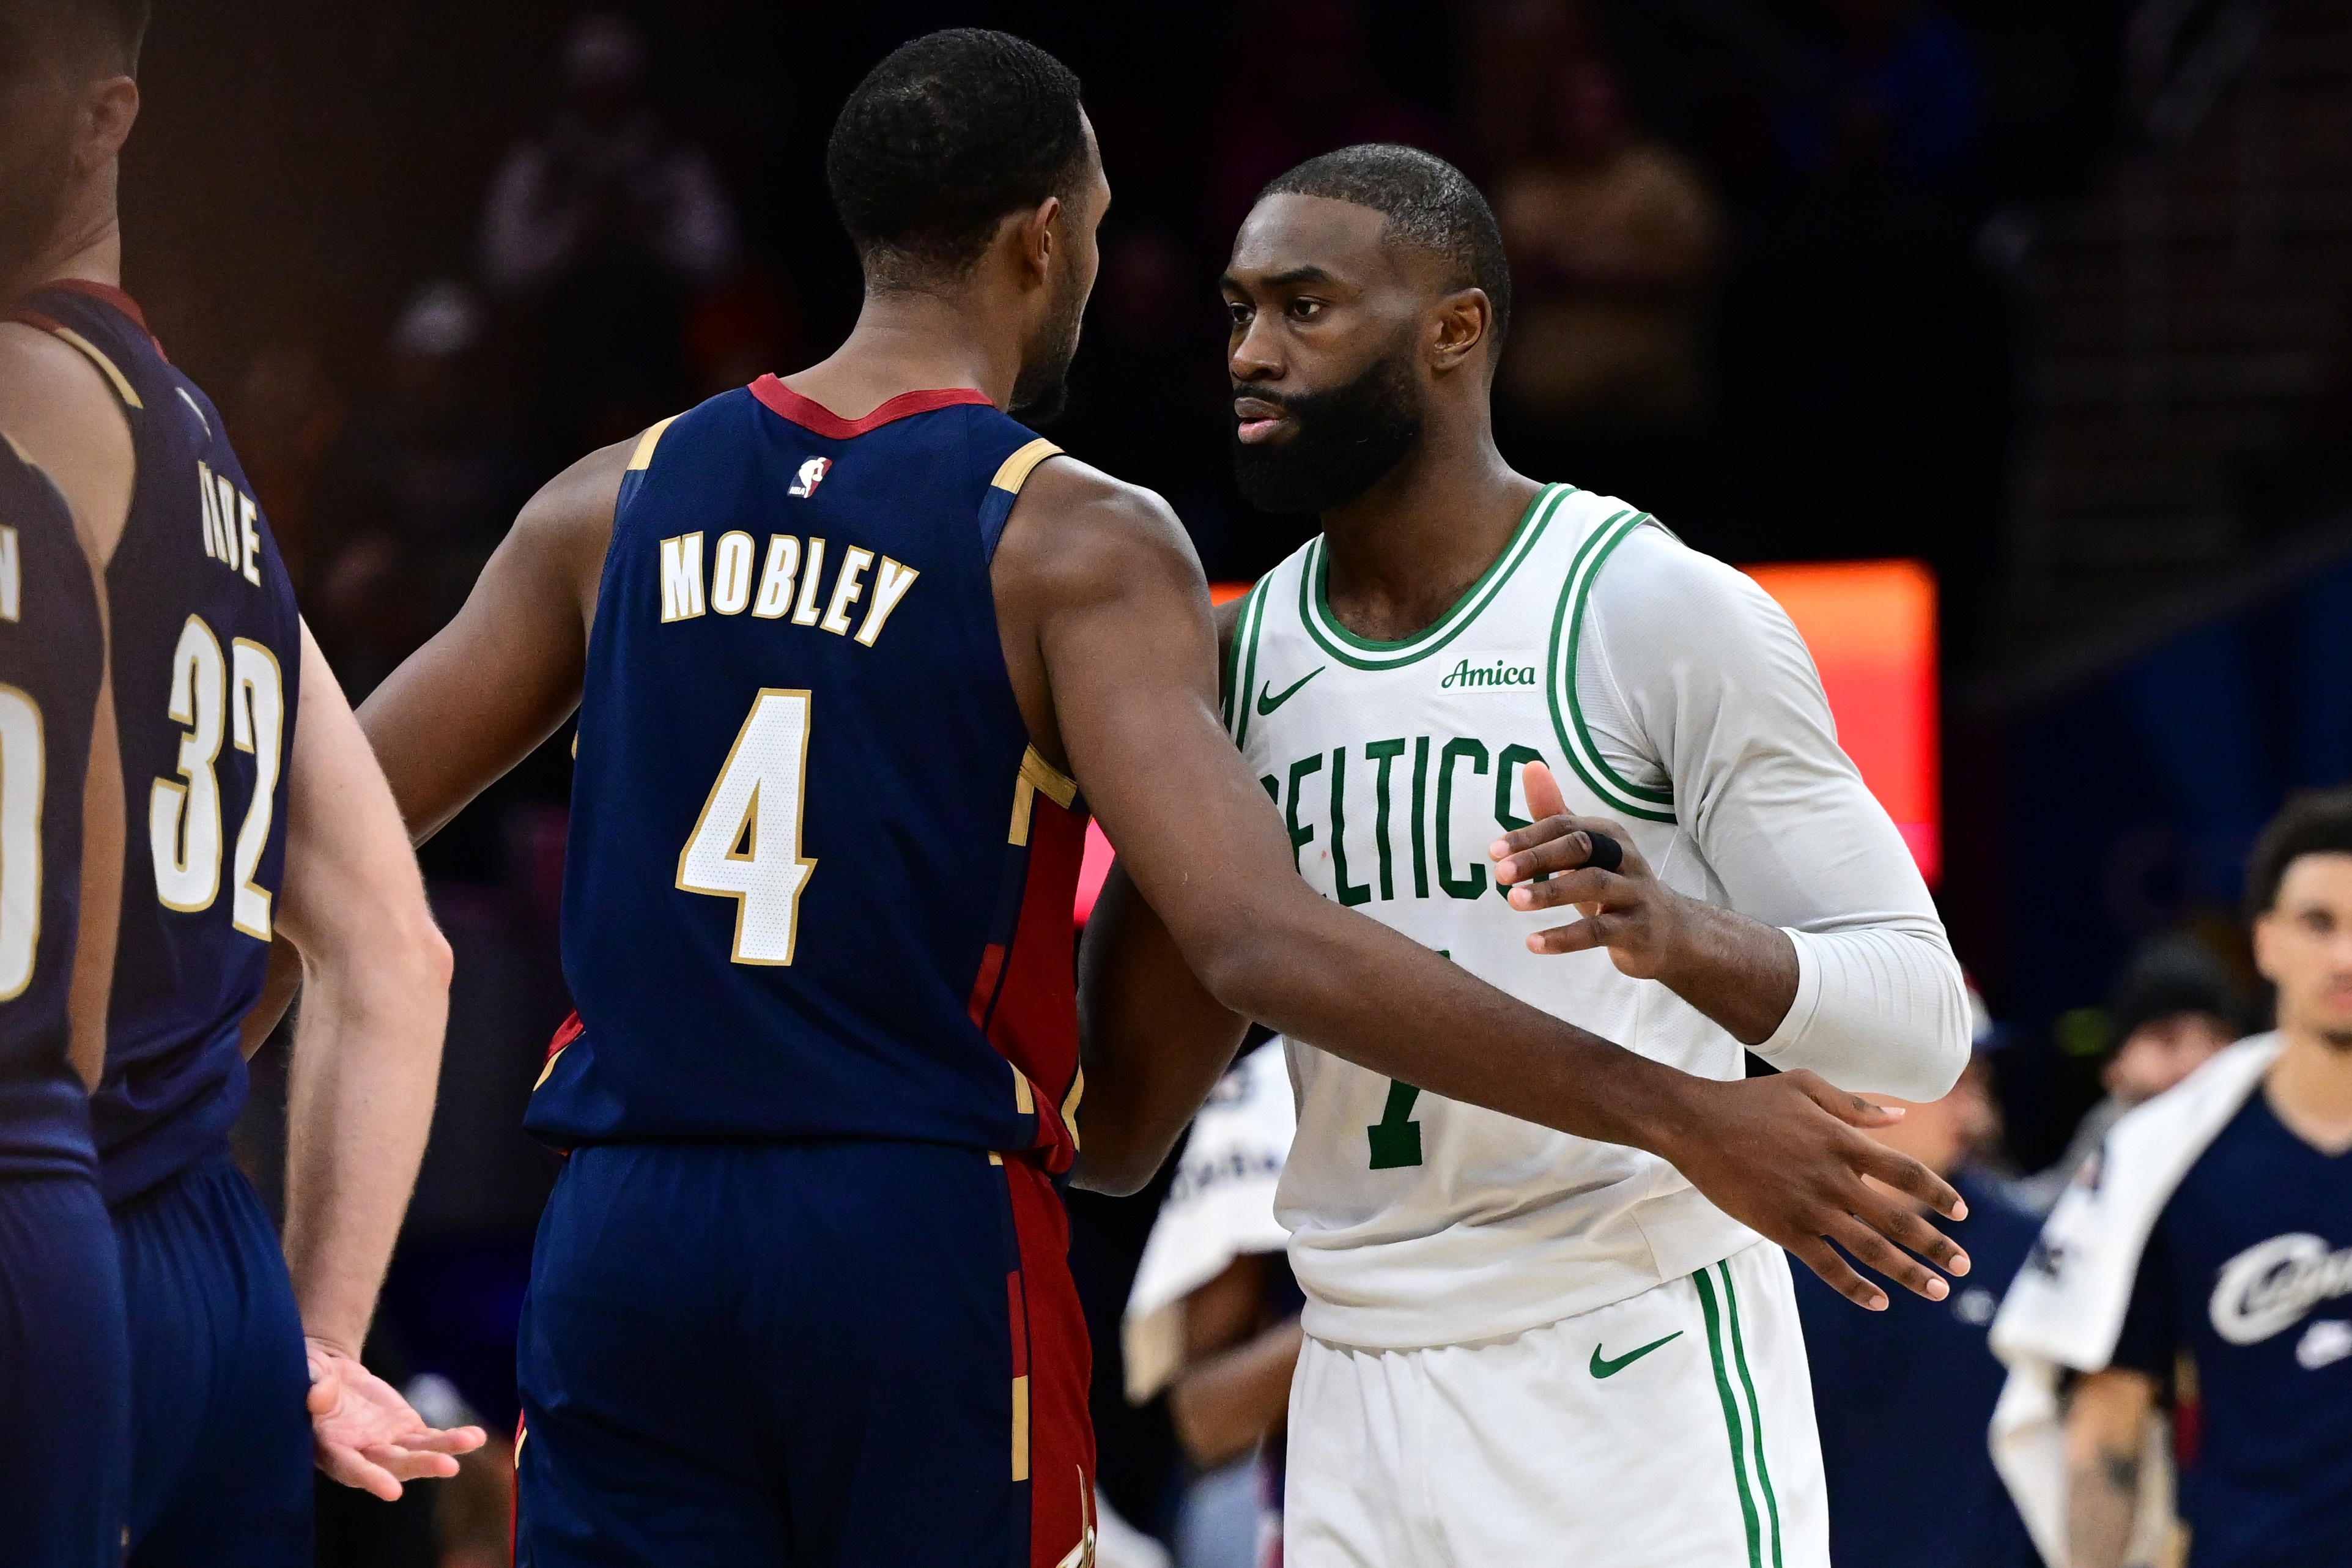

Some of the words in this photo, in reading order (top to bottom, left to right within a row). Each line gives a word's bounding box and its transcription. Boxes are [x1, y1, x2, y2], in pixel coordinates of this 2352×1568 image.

[788, 486, 806, 495] NBA
[659, 530, 920, 648] MOBLEY
[1441, 659, 1536, 689] Amica
[149, 613, 284, 942] 32
[675, 687, 818, 966] 4
[1259, 736, 1551, 907] ELTICS
